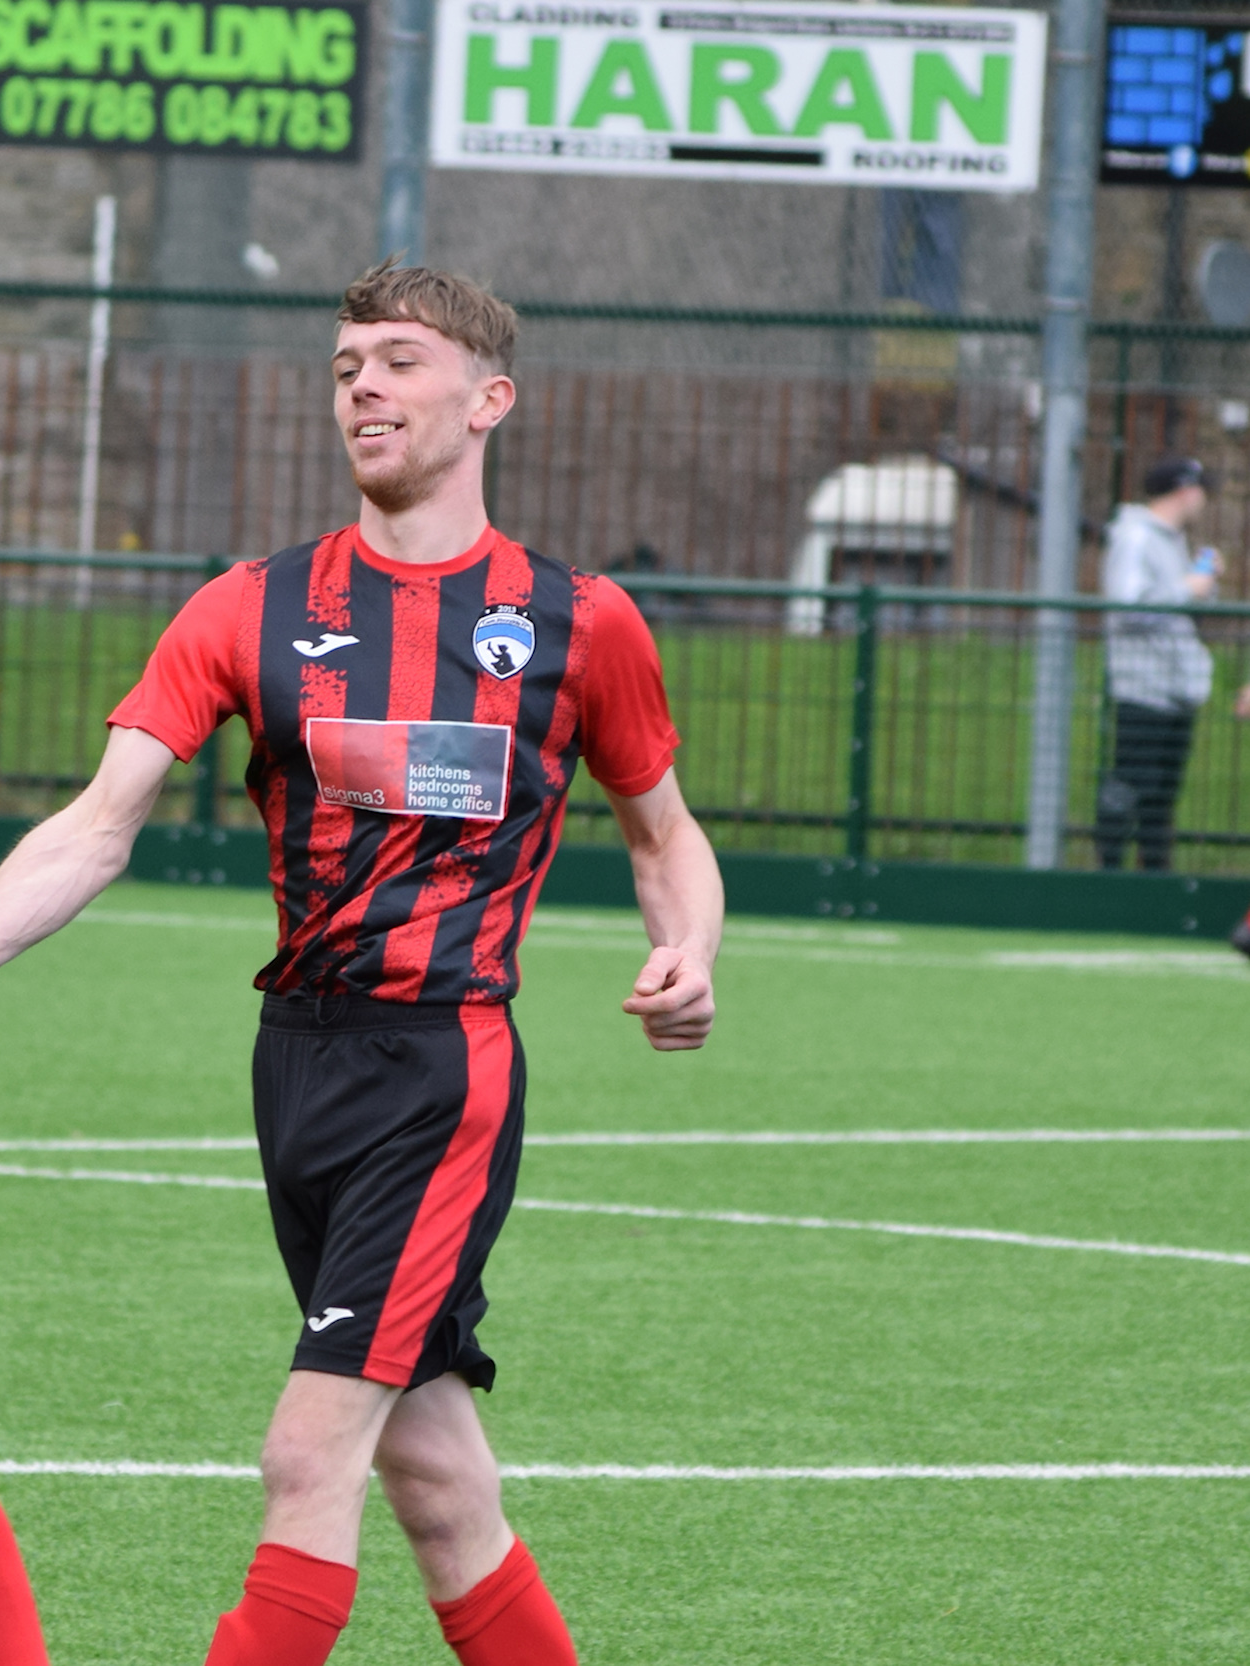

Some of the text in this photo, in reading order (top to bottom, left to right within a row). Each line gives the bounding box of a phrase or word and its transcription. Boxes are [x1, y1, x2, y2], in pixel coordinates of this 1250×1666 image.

[470, 4, 638, 27] CLADDING
[464, 33, 1012, 146] HARAN
[0, 76, 351, 152] 07786 084783
[853, 151, 1008, 174] ROOFING
[409, 764, 471, 781] kitchens
[323, 785, 386, 806] sigma3
[408, 778, 483, 797] bedrooms
[407, 793, 494, 812] home office
